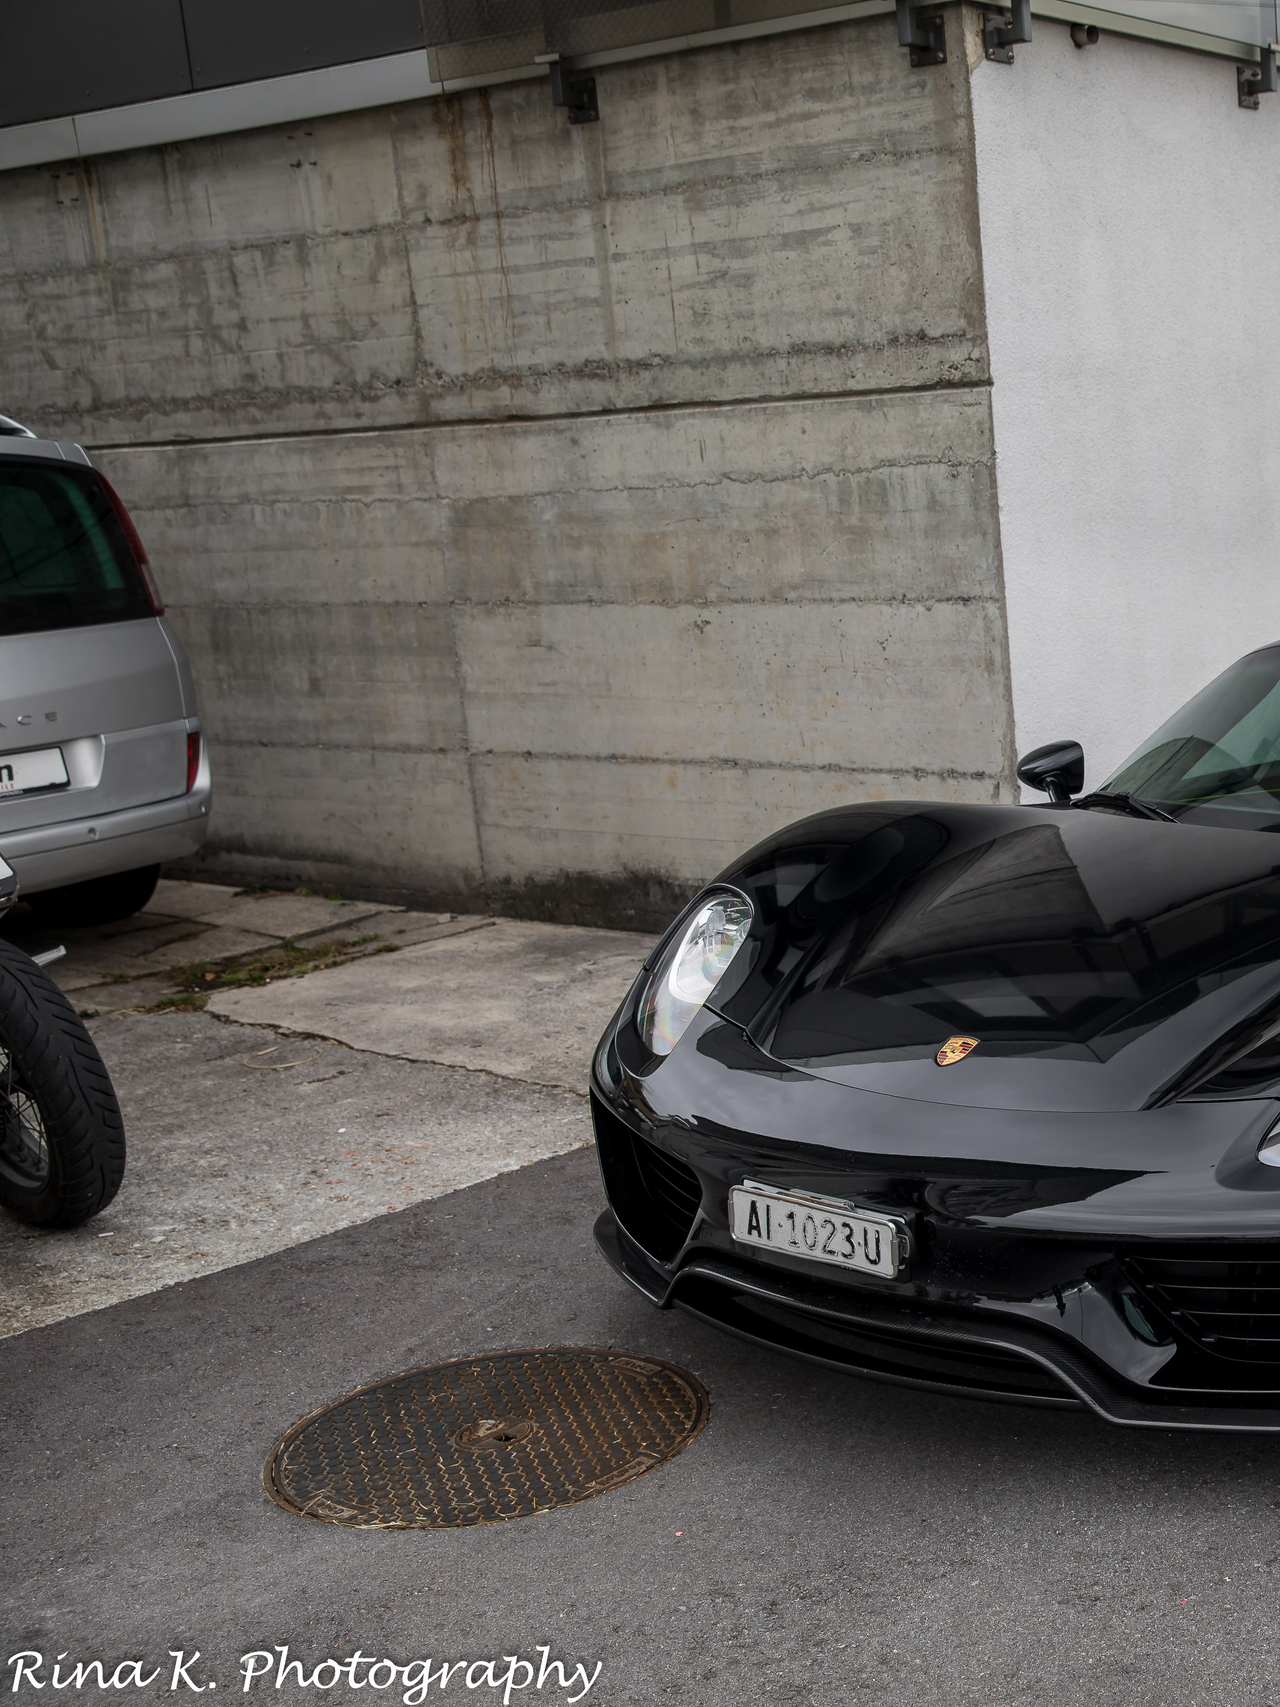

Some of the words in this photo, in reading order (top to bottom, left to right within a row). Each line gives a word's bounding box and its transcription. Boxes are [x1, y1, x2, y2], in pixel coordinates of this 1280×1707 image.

[747, 1199, 772, 1241] AI
[785, 1210, 856, 1260] 1023
[863, 1226, 882, 1266] U
